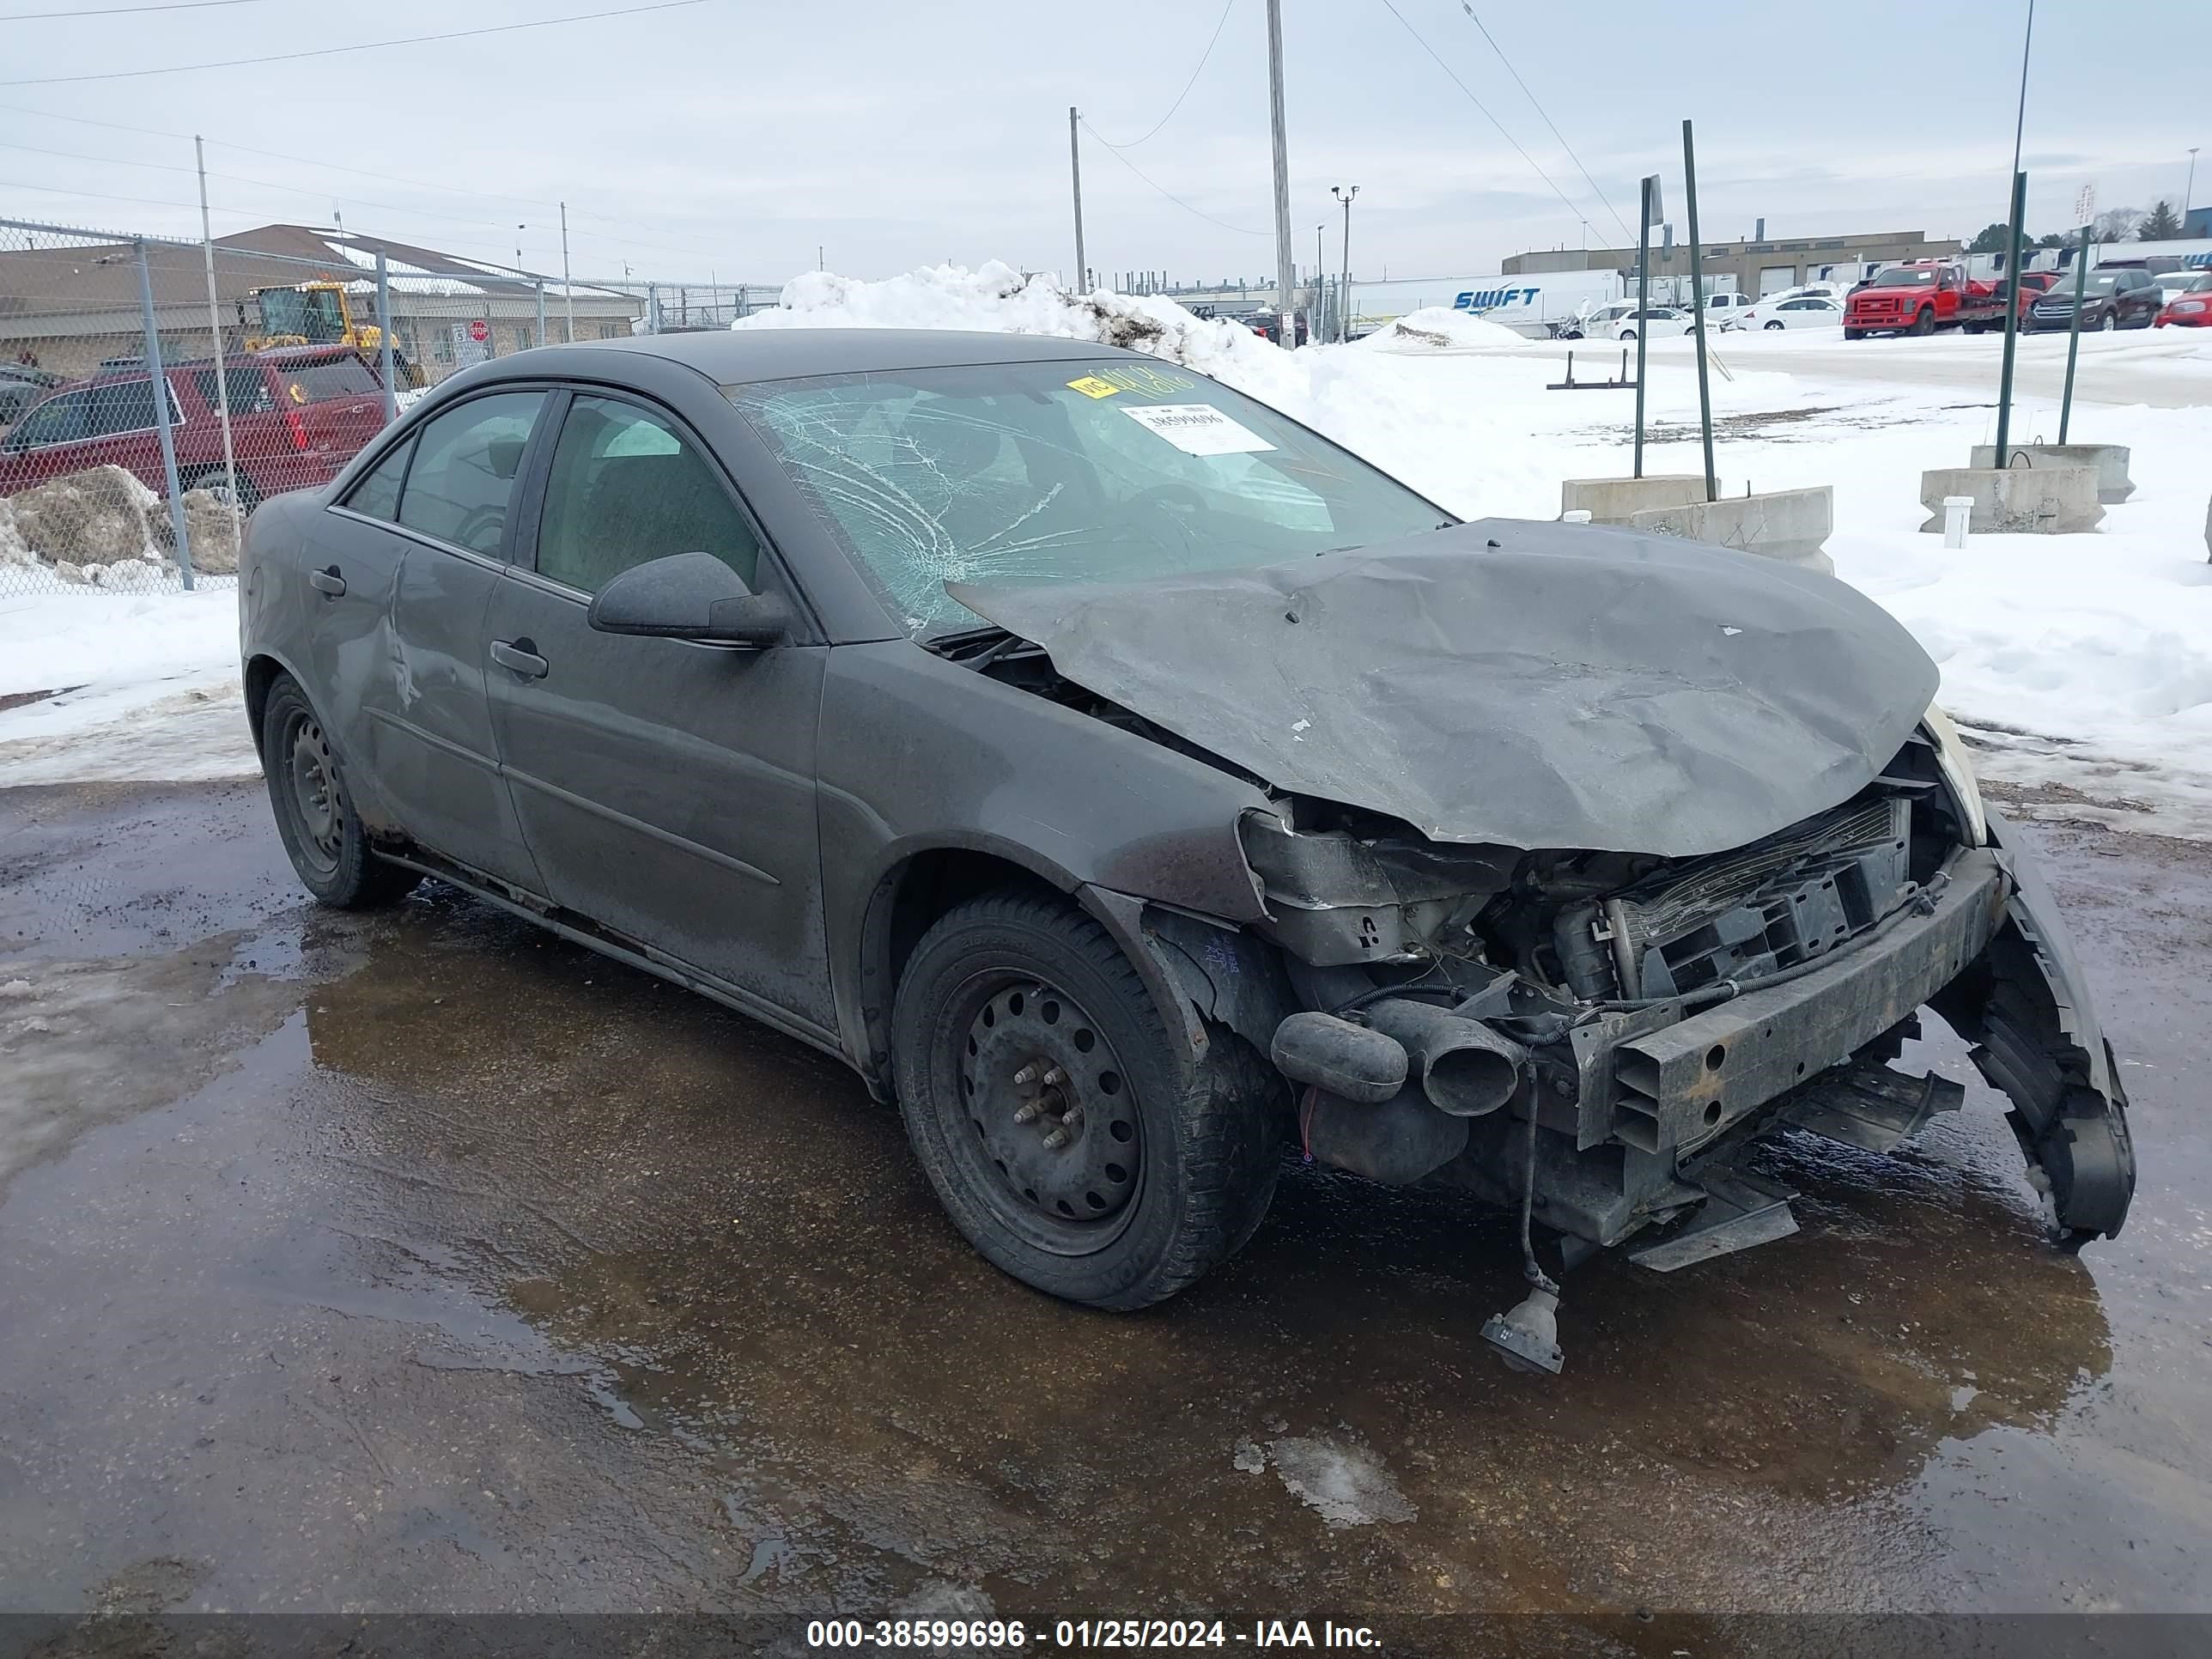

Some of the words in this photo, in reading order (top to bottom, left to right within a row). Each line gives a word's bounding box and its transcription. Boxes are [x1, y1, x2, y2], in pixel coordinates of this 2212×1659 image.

[1453, 289, 1540, 309] SWIFT
[471, 327, 489, 336] STOP
[1076, 380, 1110, 394] VIC
[1147, 414, 1223, 428] 38599696
